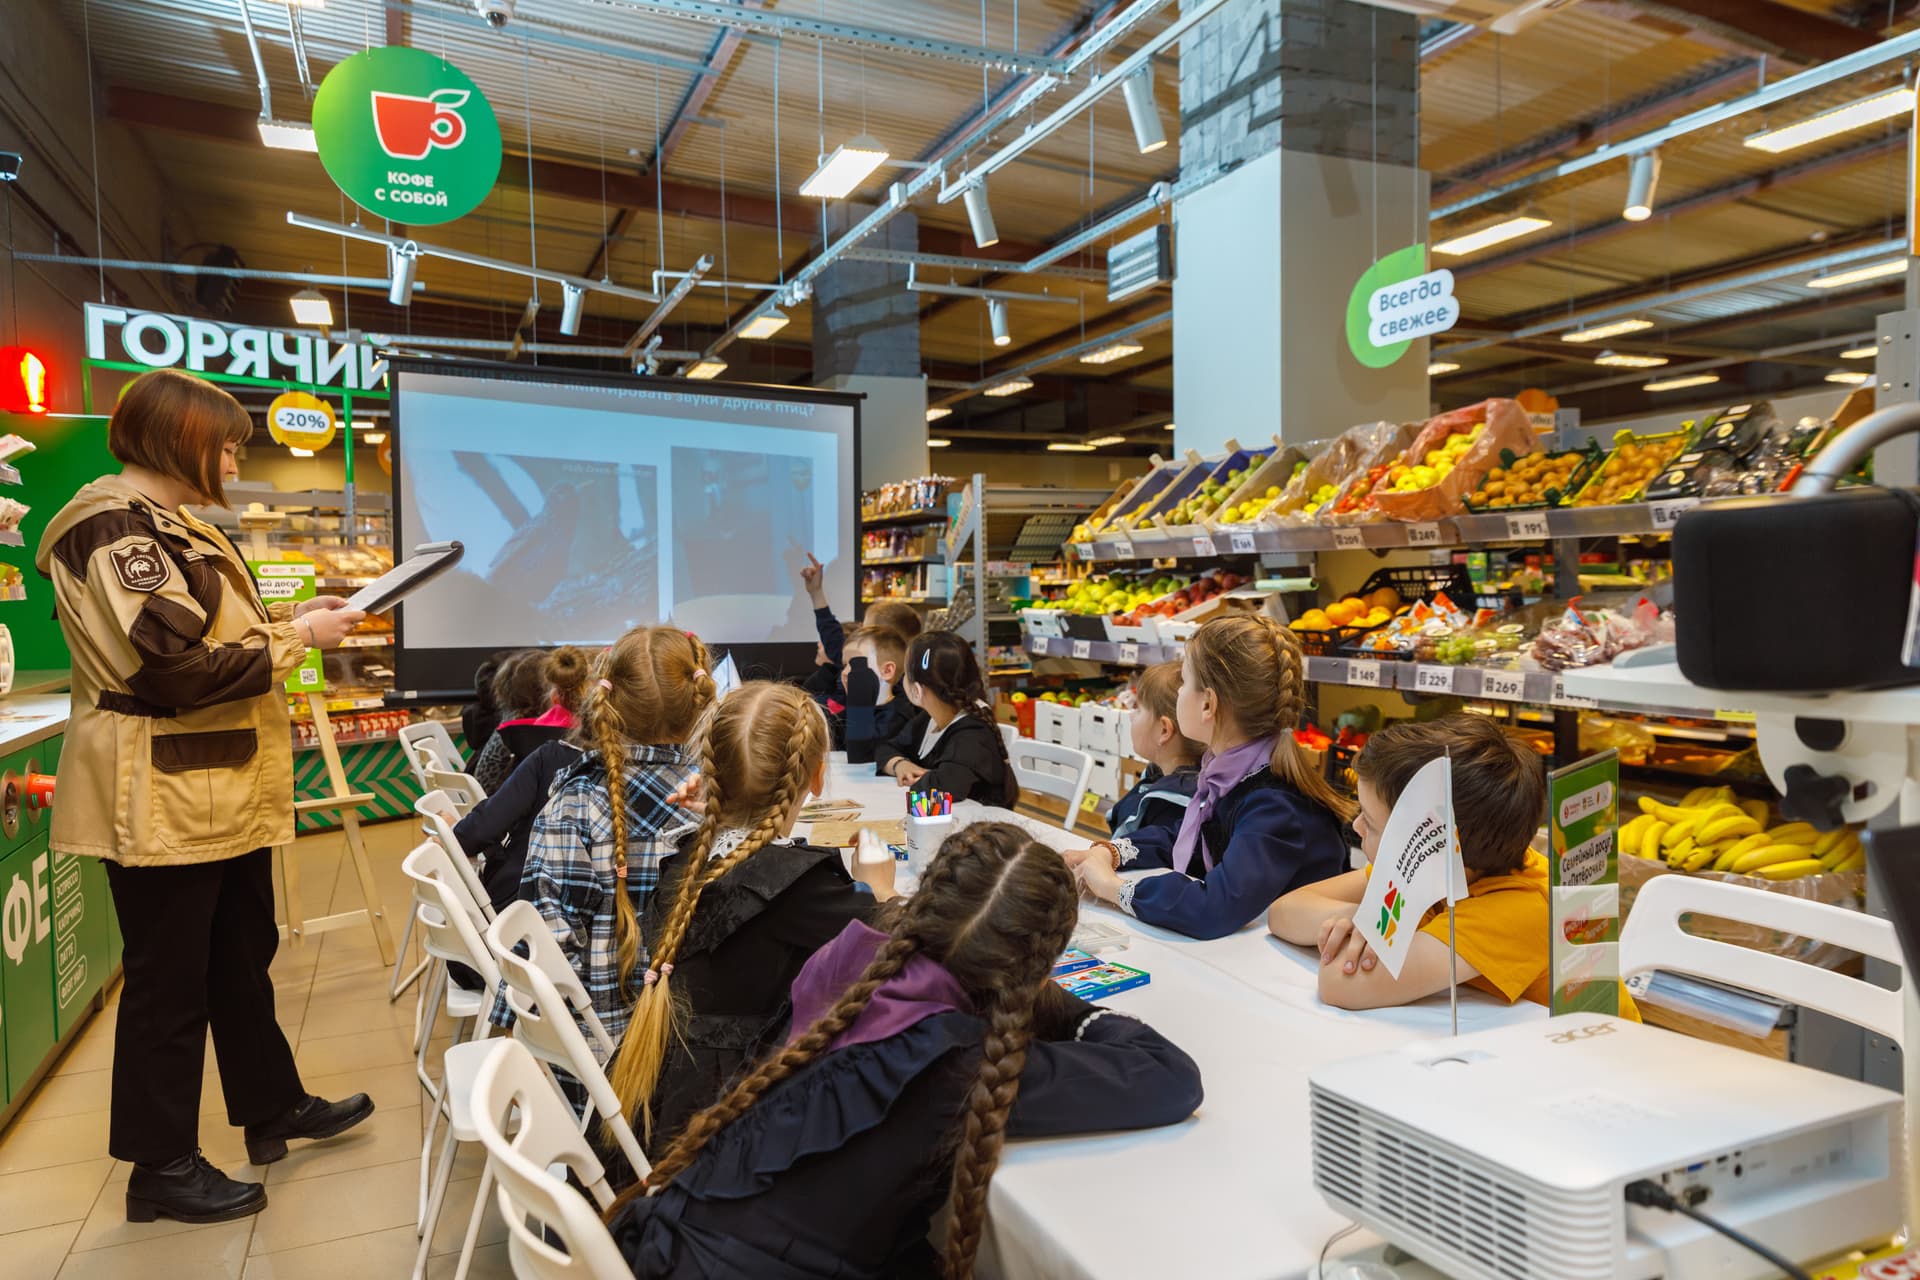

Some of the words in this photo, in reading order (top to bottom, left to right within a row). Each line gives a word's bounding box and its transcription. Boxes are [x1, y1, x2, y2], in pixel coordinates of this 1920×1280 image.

[387, 170, 434, 188] КОФЕ
[374, 188, 386, 201] С
[390, 189, 448, 207] СОБОЙ
[1379, 280, 1442, 312] Всегда
[1379, 307, 1449, 337] свежее
[86, 304, 389, 391] ГОРЯЧИЙ
[677, 392, 719, 407] звуки
[722, 396, 771, 412] других
[775, 403, 815, 417] птиц?
[278, 412, 327, 430] -20%
[1359, 669, 1375, 681] 149
[1428, 674, 1447, 686] 229
[1495, 681, 1518, 694] 269
[1396, 817, 1433, 871] Центры
[1544, 1022, 1617, 1044] acer
